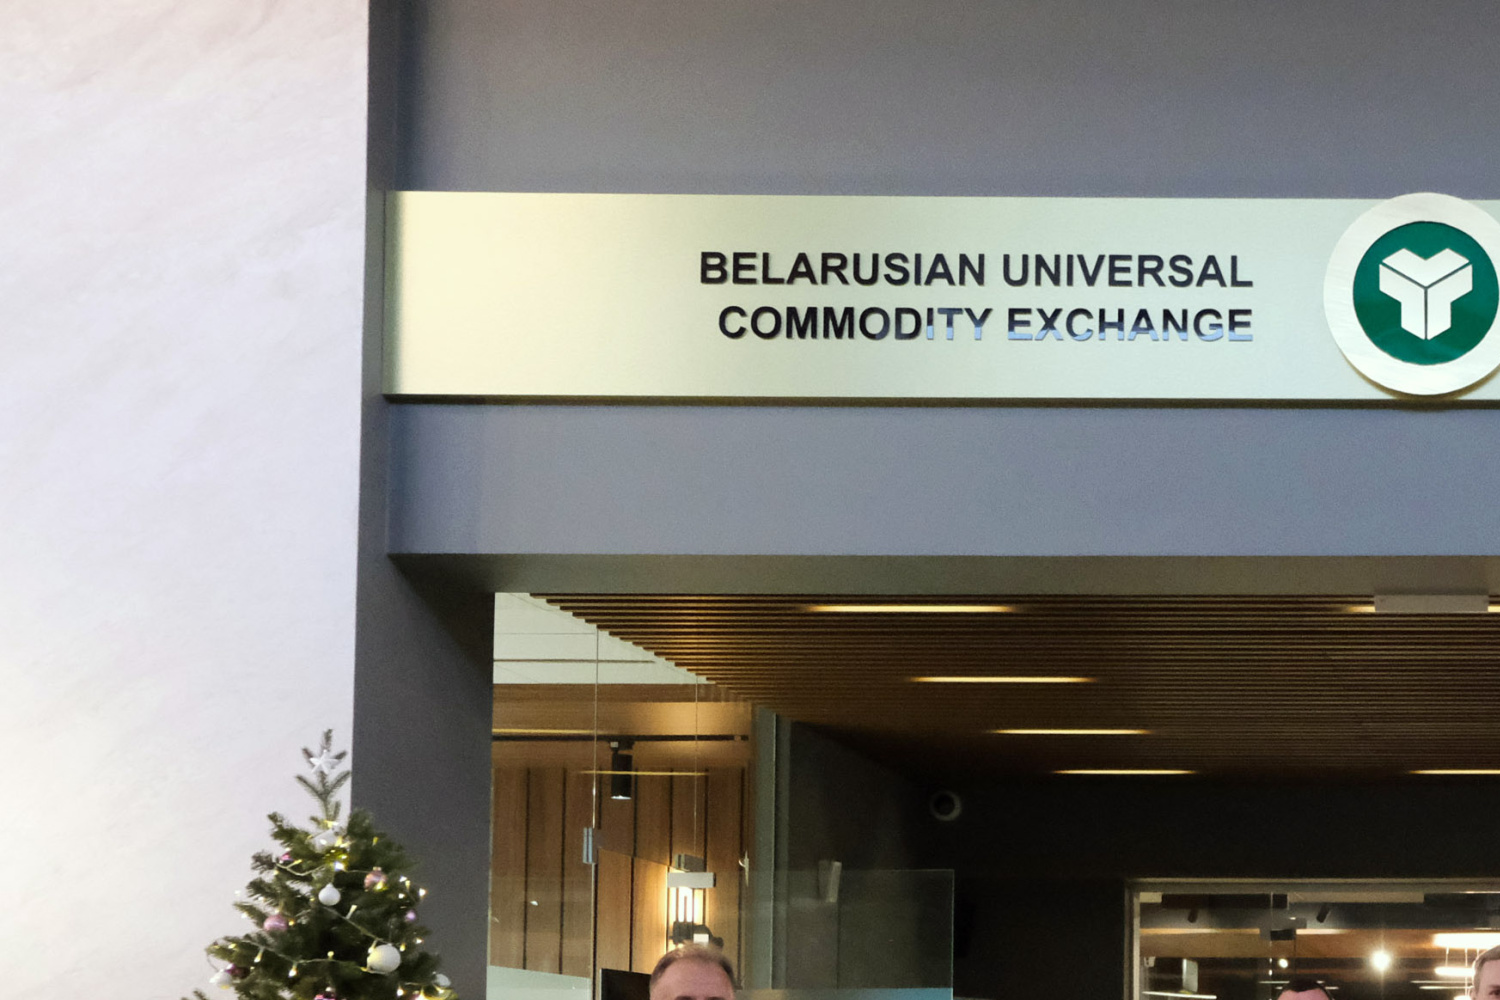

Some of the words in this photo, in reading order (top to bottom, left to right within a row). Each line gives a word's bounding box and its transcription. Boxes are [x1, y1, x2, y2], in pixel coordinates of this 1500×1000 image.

[700, 252, 985, 287] BELARUSIAN
[1003, 254, 1254, 288] UNIVERSAL
[718, 306, 993, 341] COMMODITY
[1007, 308, 1254, 343] EXCHANGE
